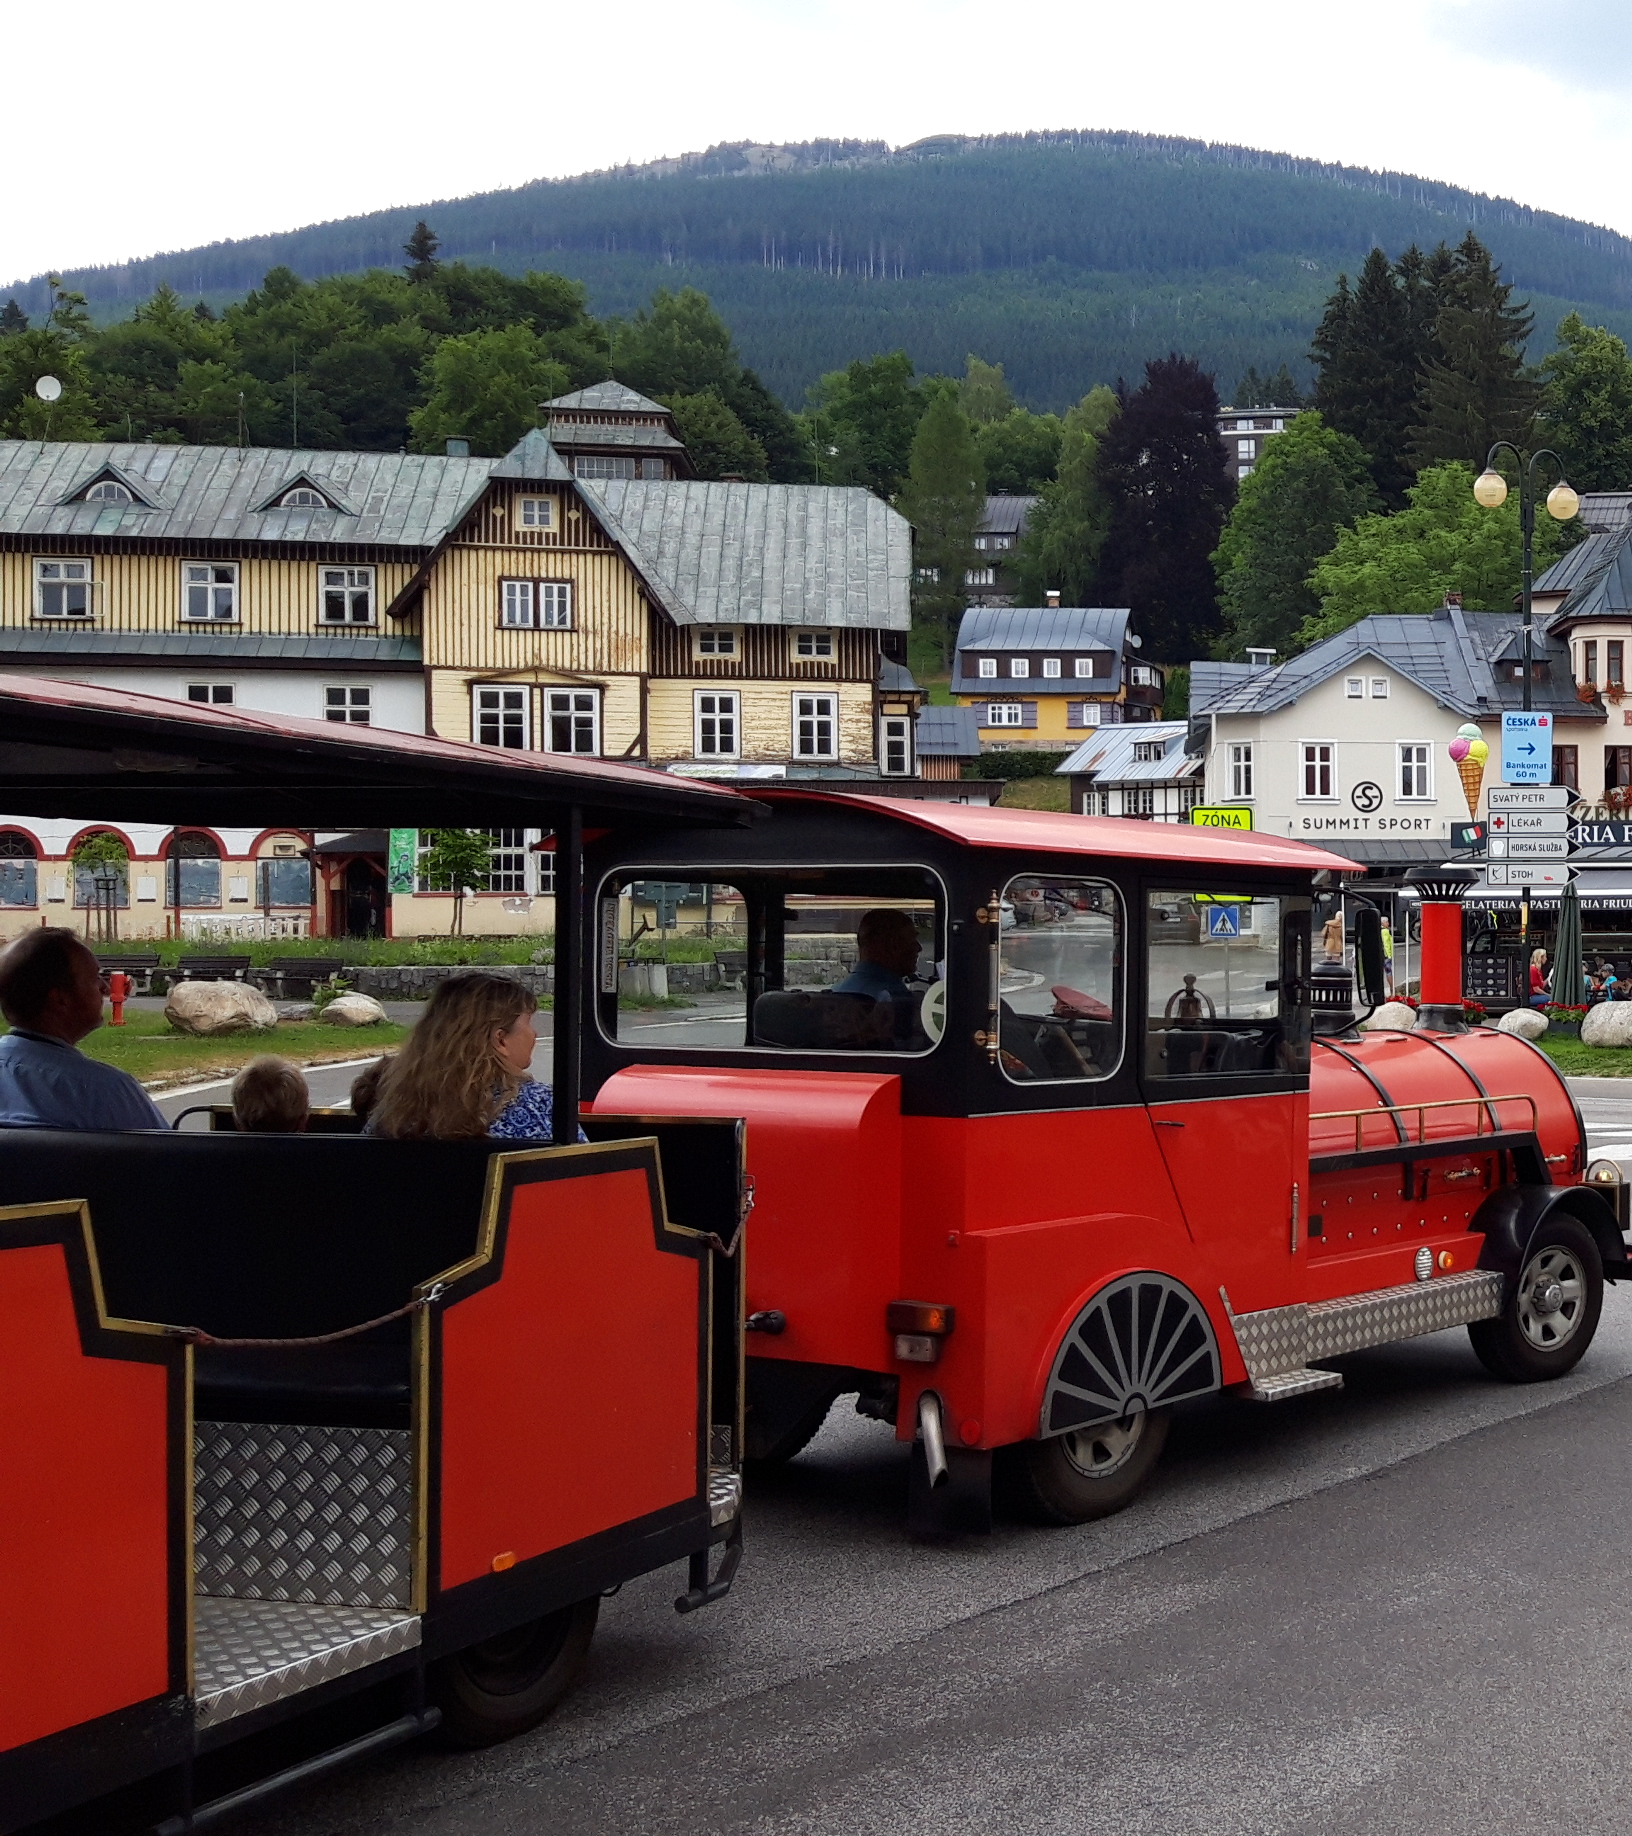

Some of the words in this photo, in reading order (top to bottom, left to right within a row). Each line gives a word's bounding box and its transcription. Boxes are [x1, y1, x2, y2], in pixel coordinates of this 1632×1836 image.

[1506, 716, 1536, 726] ČESKÁ
[1492, 793, 1519, 802] SVATÝ
[1202, 811, 1242, 827] ZÓNA
[1511, 819, 1542, 827] LÉKAŘ
[1302, 818, 1370, 830] SUMMIT
[1378, 818, 1432, 830] SPORT
[1511, 842, 1537, 852] HORSKÁ
[1538, 842, 1562, 851] SLUŽBA
[1511, 870, 1533, 878] STOH
[1530, 900, 1599, 909] PASTIRIA
